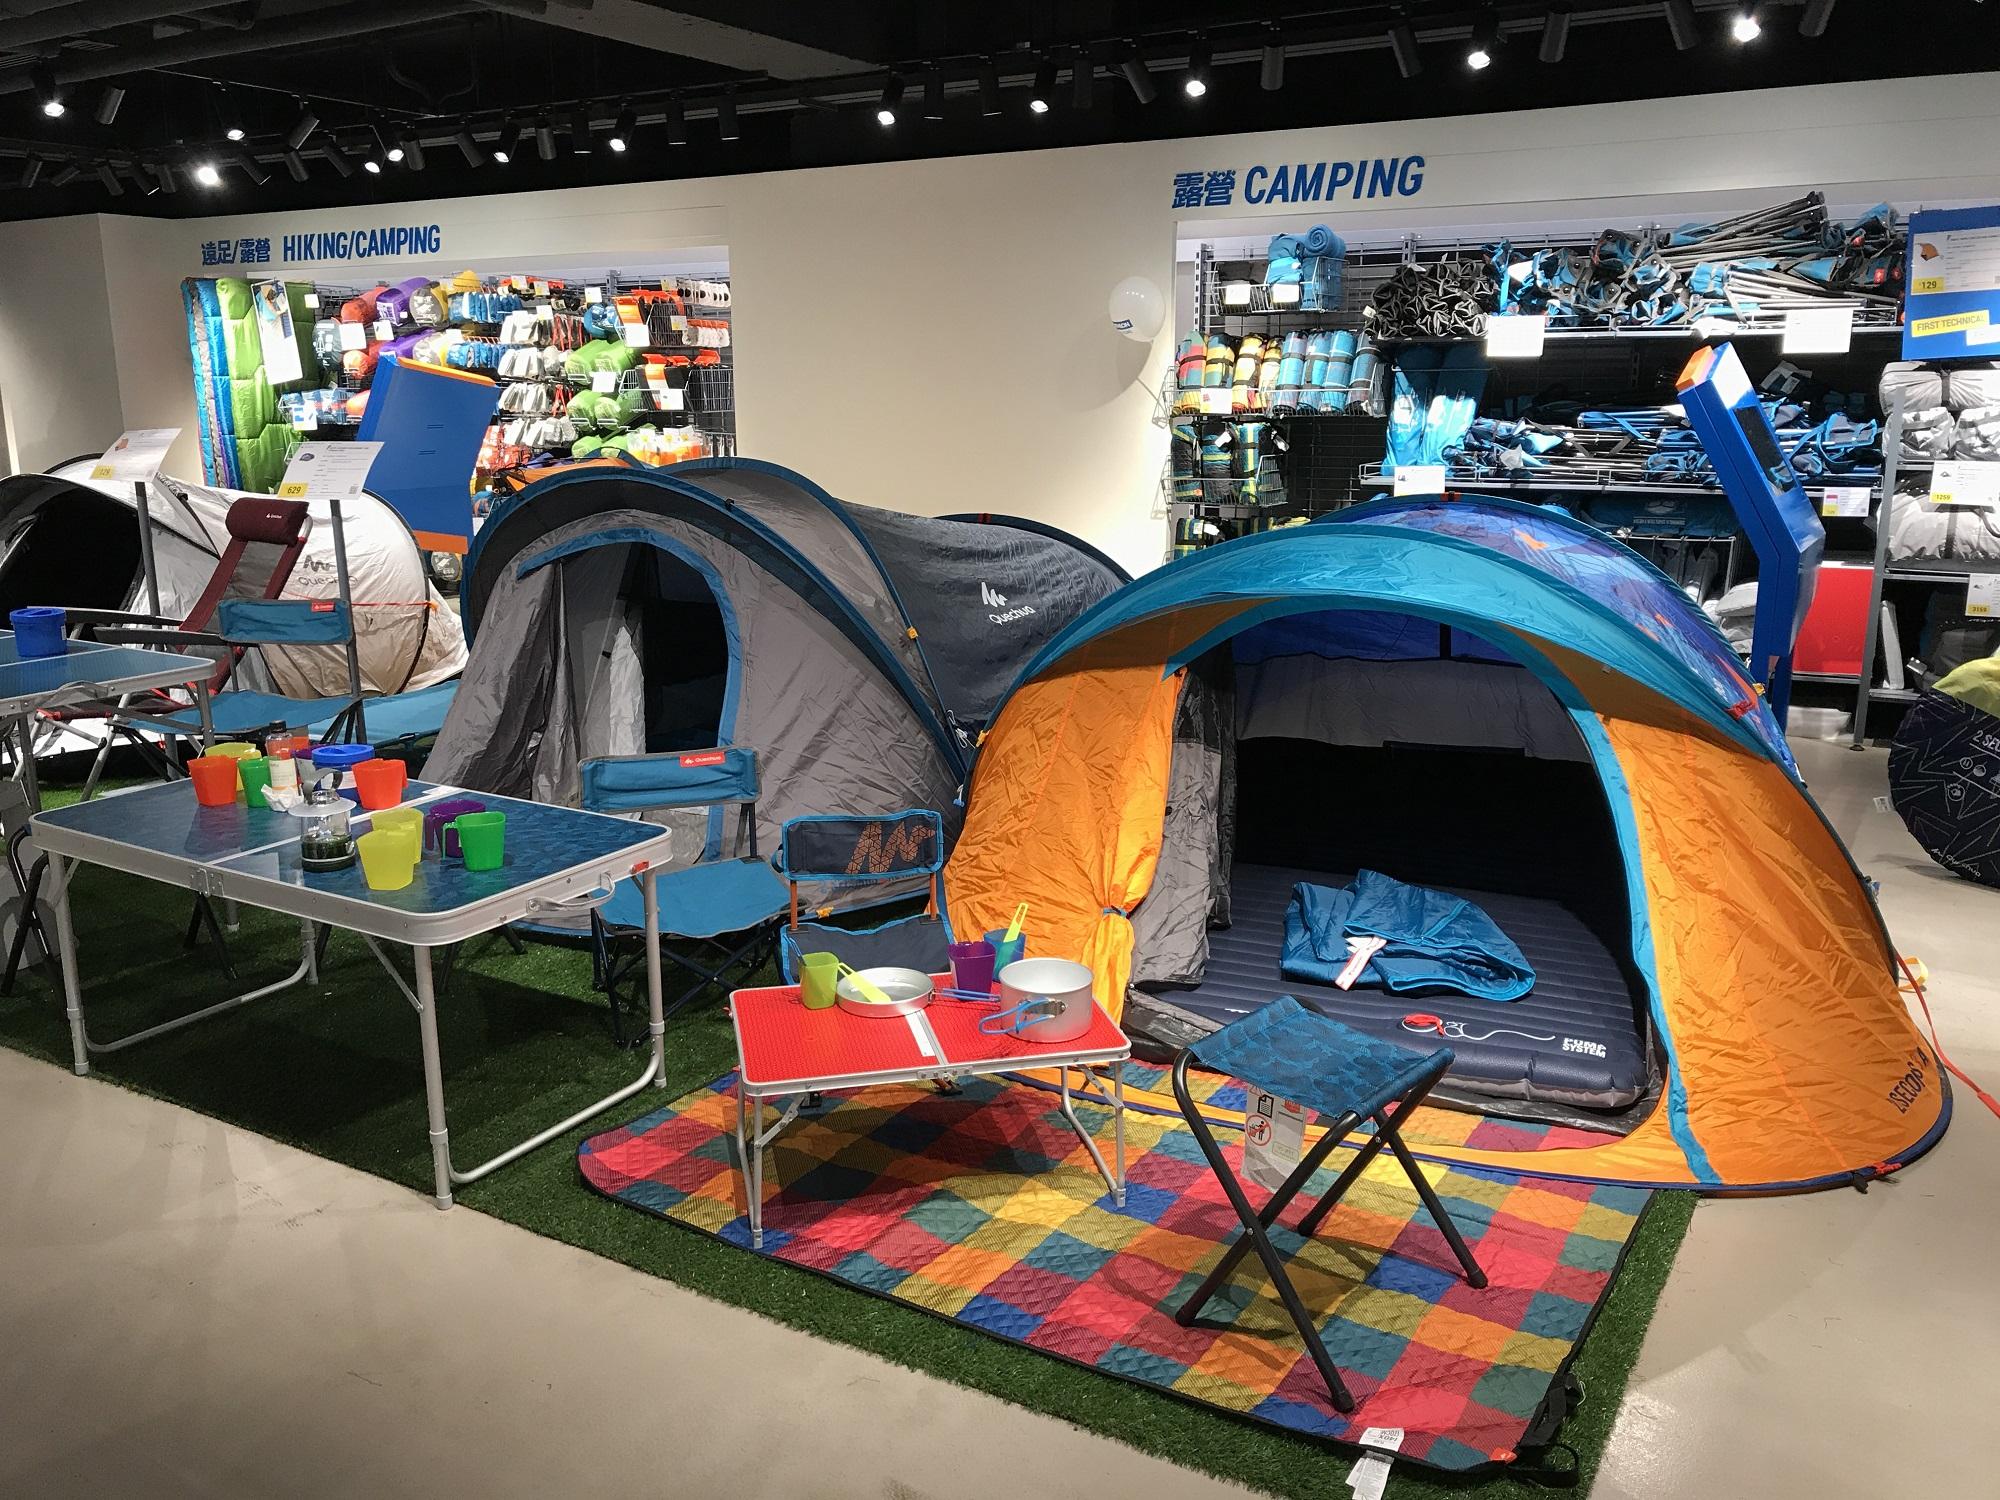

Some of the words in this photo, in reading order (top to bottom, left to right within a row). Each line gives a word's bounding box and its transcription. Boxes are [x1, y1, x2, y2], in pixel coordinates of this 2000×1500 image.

[1172, 170, 1236, 208] 露營
[1244, 155, 1425, 205] CAMPING
[283, 224, 441, 262] HIKING/CAMPING
[1917, 321, 1940, 331] FIRST
[287, 486, 302, 495] 629
[988, 605, 1036, 626] Quechua
[1562, 1043, 1606, 1059] SYSTEM
